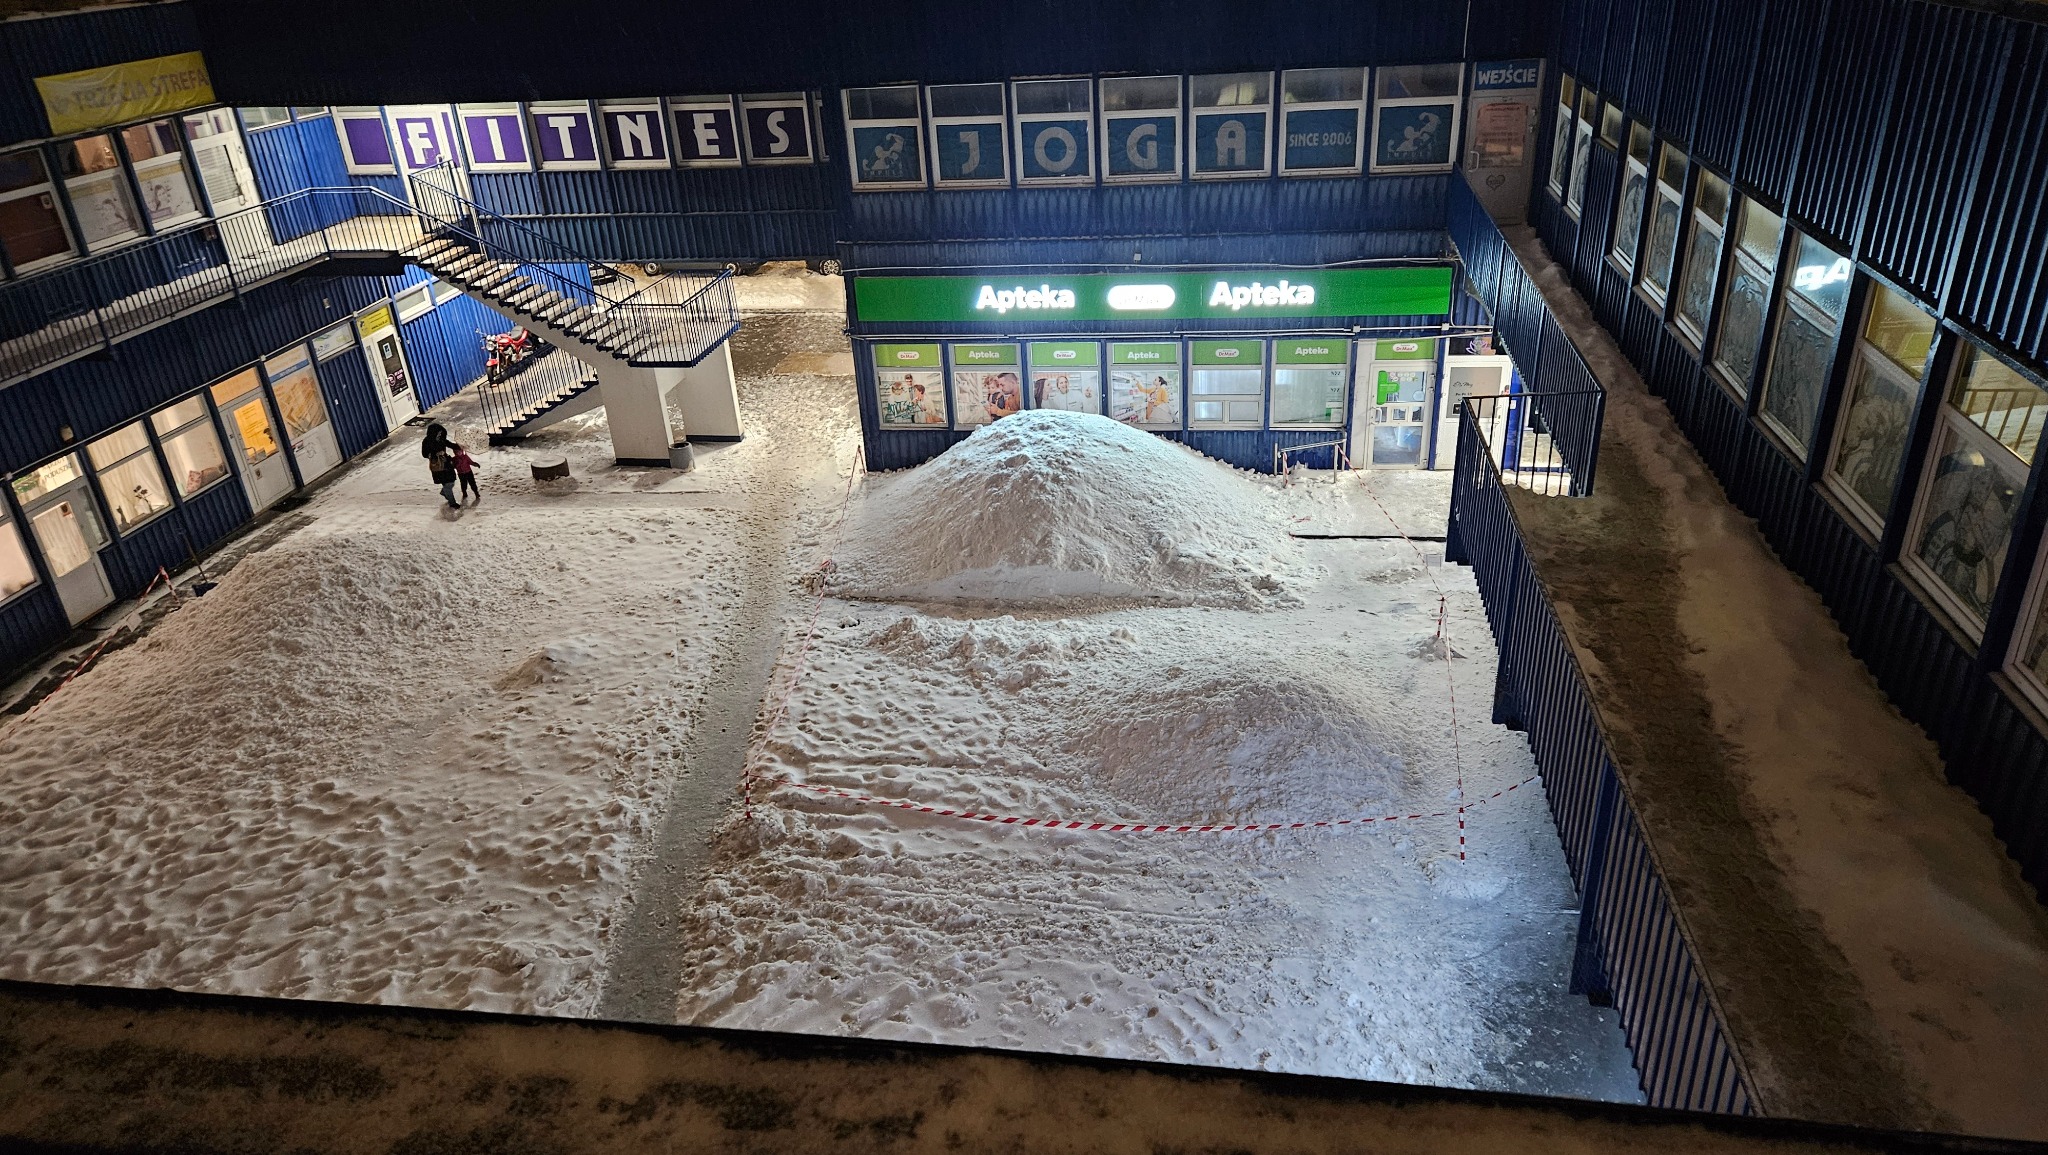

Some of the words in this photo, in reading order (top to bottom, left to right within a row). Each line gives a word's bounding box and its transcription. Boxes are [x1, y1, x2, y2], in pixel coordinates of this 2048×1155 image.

[151, 68, 211, 96] STREFA
[1478, 64, 1537, 85] WEJŚCIE
[957, 119, 1248, 174] JOGA
[1288, 133, 1320, 147] SINCE
[1322, 131, 1352, 146] 2006
[975, 284, 1076, 313] Apteka
[1209, 280, 1315, 310] Apteka
[968, 350, 1000, 360] Apteka
[1127, 351, 1160, 360] Apteka
[1295, 346, 1329, 357] Apteka
